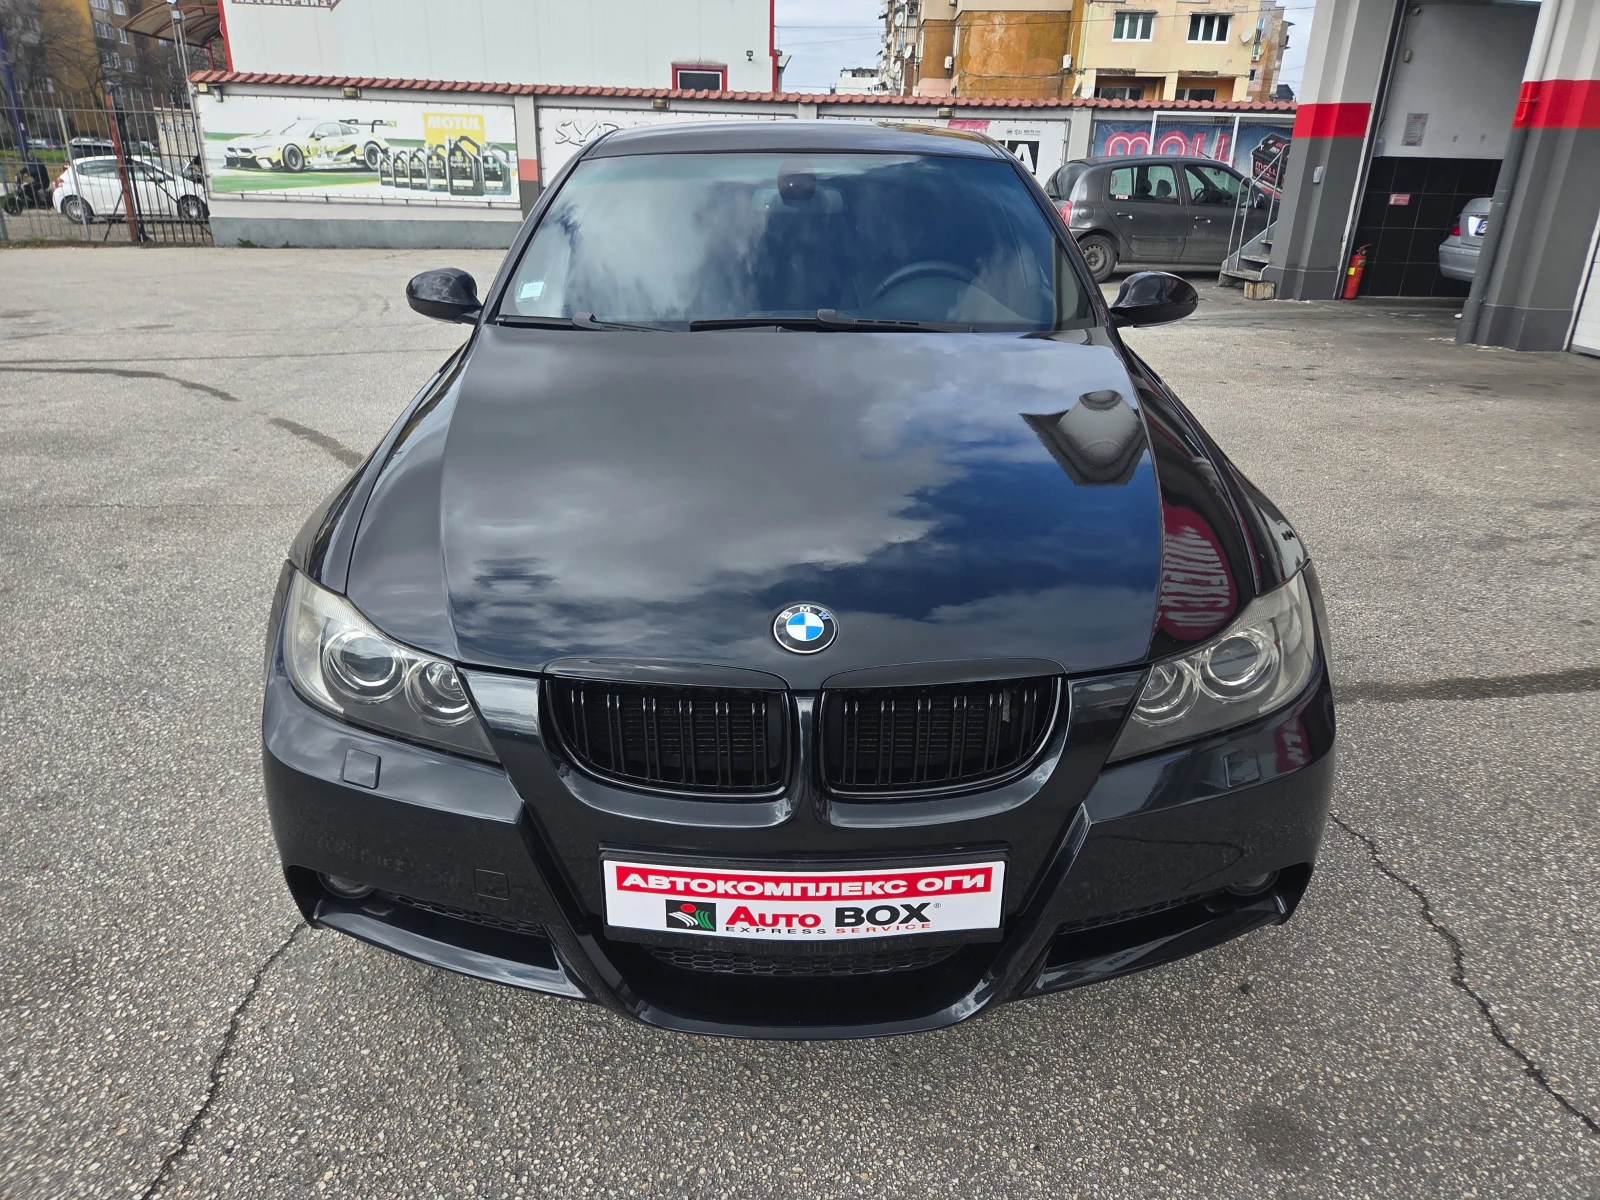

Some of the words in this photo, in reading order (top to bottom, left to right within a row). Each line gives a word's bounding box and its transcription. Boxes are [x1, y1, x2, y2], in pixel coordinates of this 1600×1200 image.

[427, 115, 482, 131] MOTUL
[780, 606, 831, 621] BMW
[621, 873, 909, 898] АВТОКОМПЛЕКС
[916, 873, 986, 893] ОГИ
[725, 926, 827, 936] EXPRESS
[835, 922, 932, 935] SERVICE
